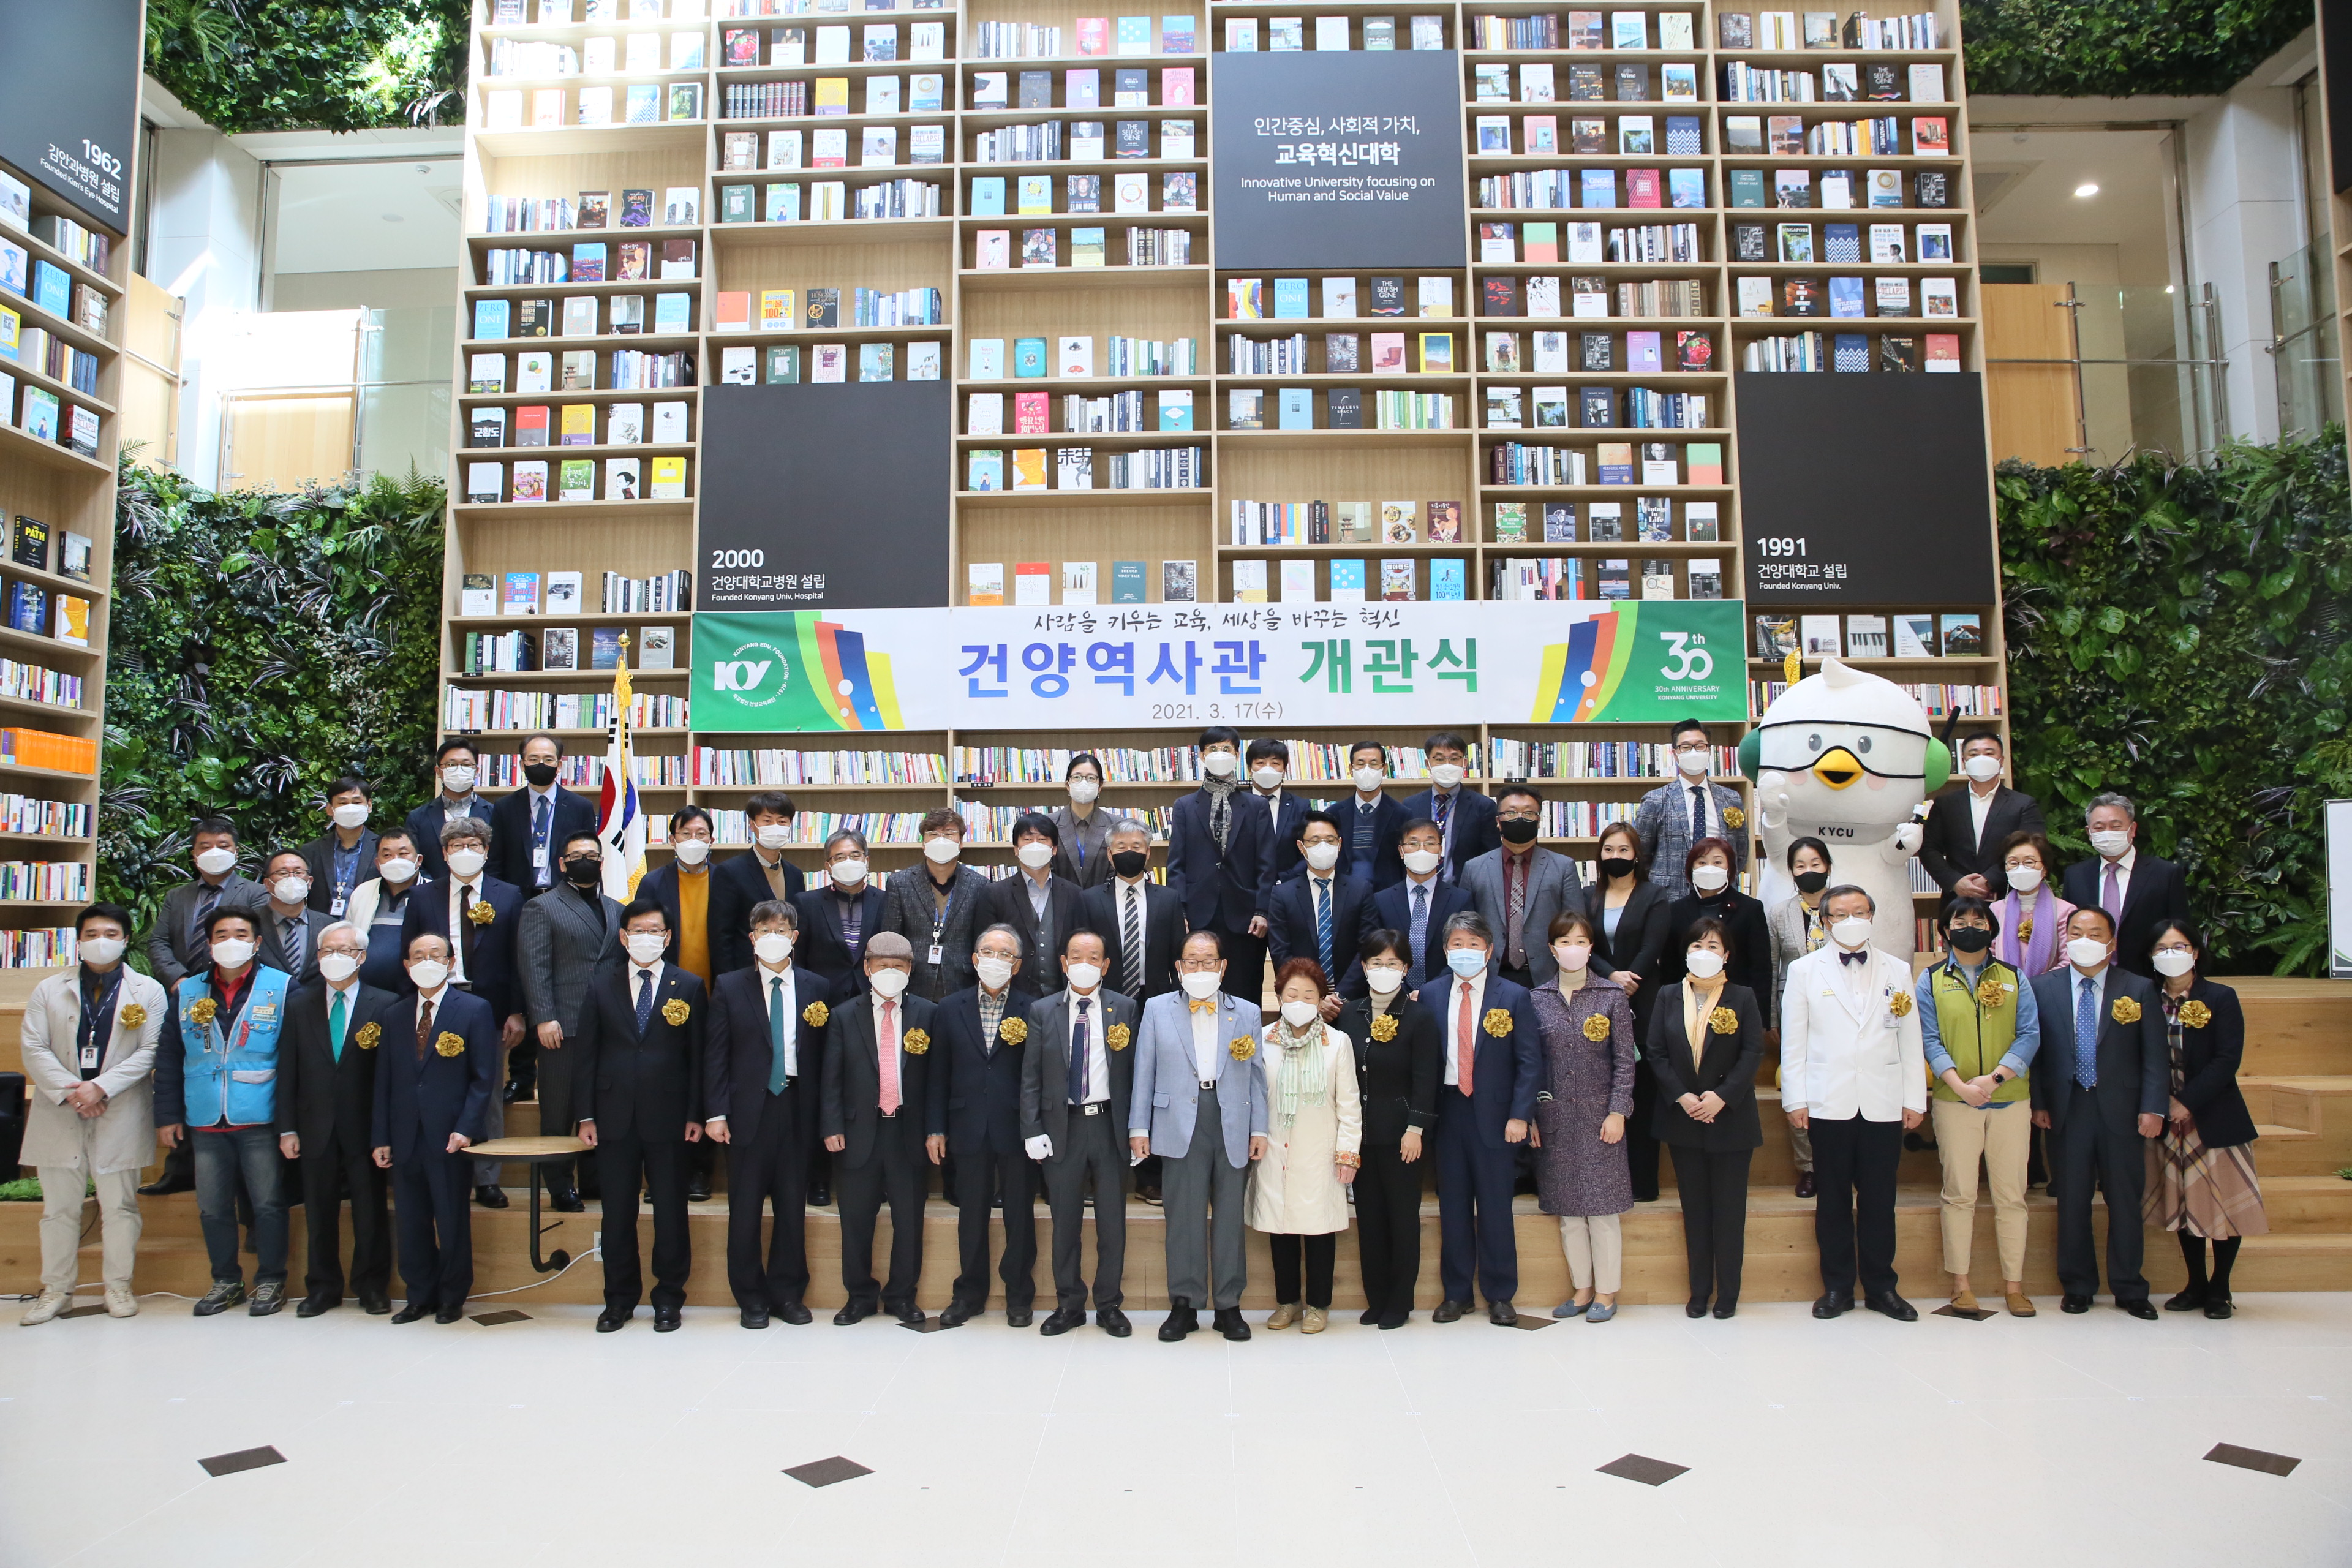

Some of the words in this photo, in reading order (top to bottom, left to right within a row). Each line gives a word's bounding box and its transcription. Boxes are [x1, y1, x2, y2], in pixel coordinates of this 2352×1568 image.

[1254, 116, 1324, 136] 인간중심,
[1329, 116, 1378, 135] 사회적
[1382, 116, 1420, 135] 가치,
[82, 138, 122, 181] 1962
[1275, 141, 1401, 167] 교육혁신대학
[48, 143, 99, 189] 김안과병원
[100, 179, 119, 203] 설립
[40, 157, 67, 181] Founded
[68, 176, 84, 192] Kim's
[85, 187, 96, 200] Eye
[96, 193, 118, 214] Hospital
[1241, 177, 1302, 187] Innovative
[1304, 176, 1364, 190] University
[1366, 176, 1417, 189] focusing
[1420, 178, 1436, 187] on
[1268, 191, 1311, 202] Human
[1313, 190, 1335, 201] and
[1339, 189, 1373, 201] Social
[1376, 189, 1409, 200] Value
[44, 267, 68, 285] ZERO
[45, 282, 66, 300] ONE
[1280, 294, 1304, 303] ONE
[479, 315, 502, 324] ONE
[767, 308, 782, 318] 100
[74, 417, 97, 433] COLLAPSE
[474, 426, 500, 438] 군함도
[25, 526, 45, 542] PATH
[1757, 537, 1807, 556] 1991
[712, 549, 764, 568] 2000
[1758, 564, 1820, 579] 건양대학교
[1822, 564, 1847, 579] 설립
[712, 574, 797, 590] 건양대학교병원
[801, 573, 825, 589] 설립
[1186, 564, 1194, 598] BEYOND
[1792, 582, 1822, 591] Konyang
[744, 593, 774, 601] Konyang
[795, 592, 823, 600] Hospital
[1034, 610, 1097, 633] 사람을
[1108, 610, 1163, 633] 키우는
[1174, 608, 1212, 633] 교육,
[1222, 608, 1281, 631] 세상을
[1292, 609, 1348, 628] 바꾸는
[1359, 608, 1400, 630] 혁신
[565, 630, 574, 666] BEYOND
[733, 642, 759, 657] KONYANG
[772, 647, 789, 680] FOUNDATION
[958, 639, 1267, 698] 건양역사관
[1298, 638, 1477, 693] 개관식
[777, 683, 787, 696] 1979
[733, 693, 748, 706] 학교법인
[749, 696, 777, 707] 건양교육재단
[1152, 704, 1199, 720] 2021.
[1209, 704, 1225, 719] 3.
[1234, 701, 1283, 720] 17(수)
[1818, 826, 1854, 838] KYCU
